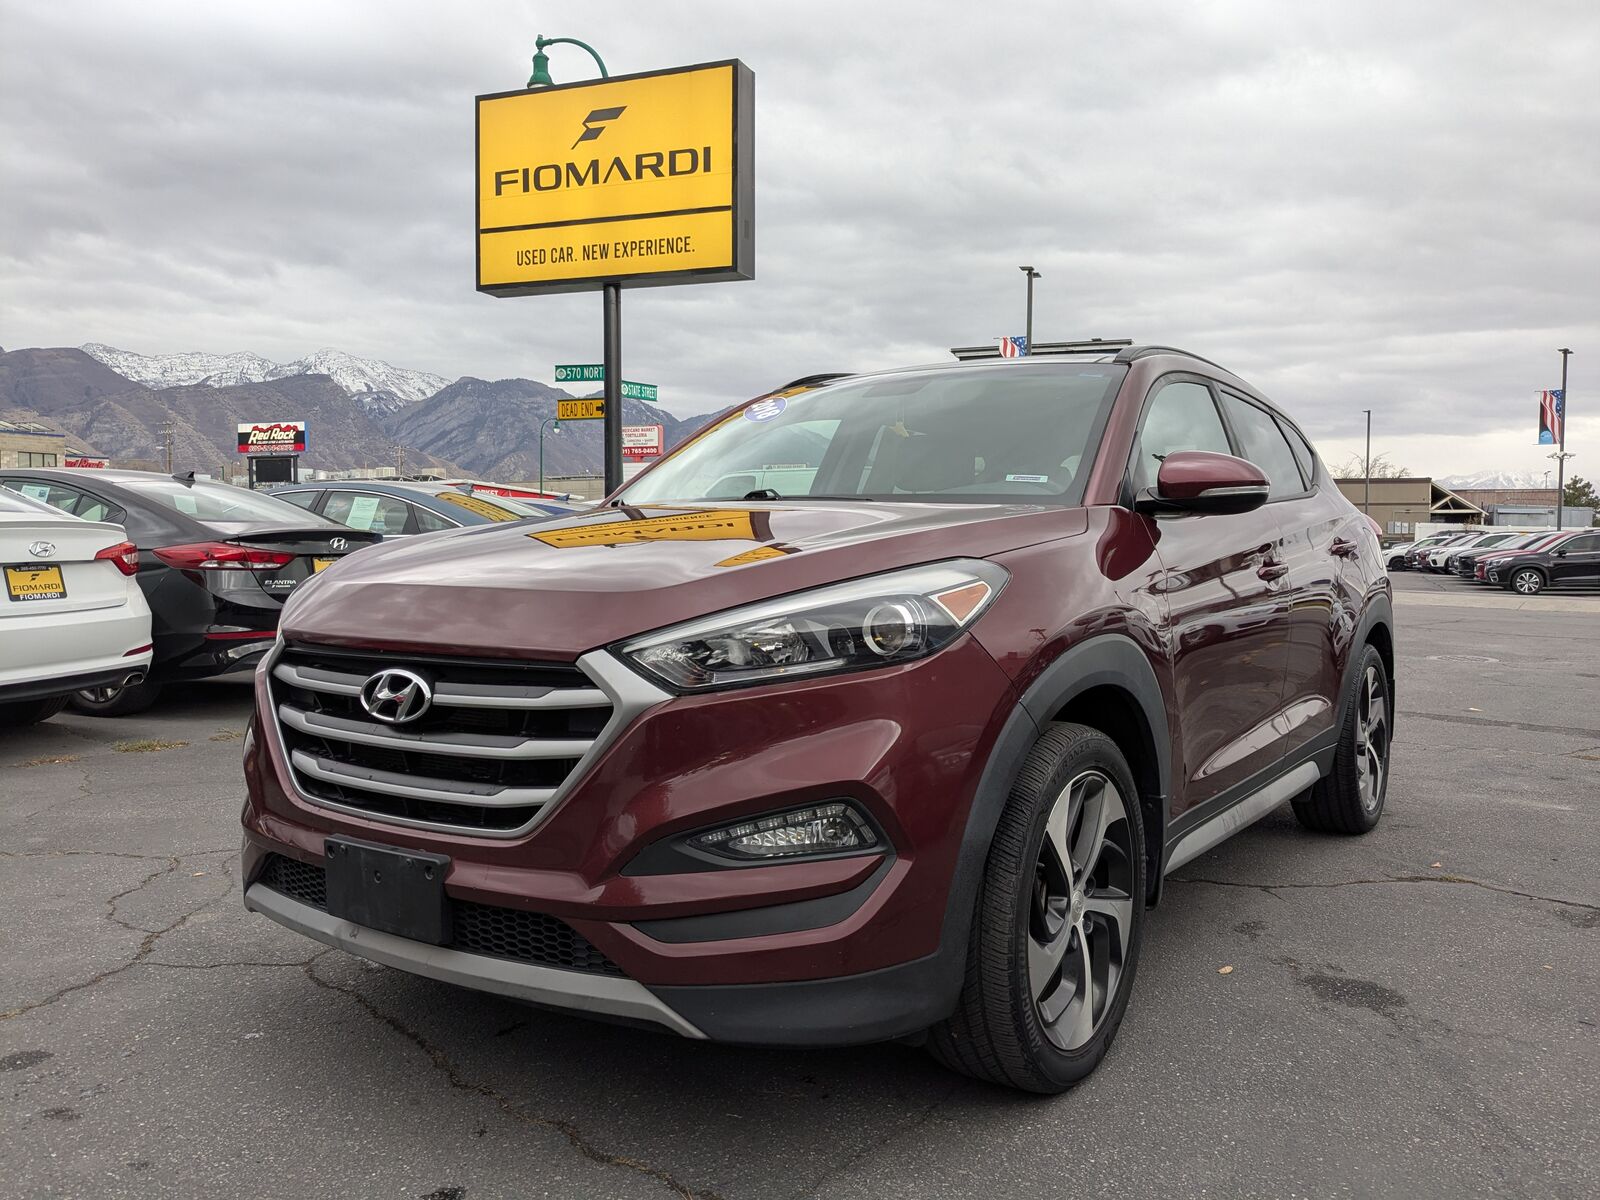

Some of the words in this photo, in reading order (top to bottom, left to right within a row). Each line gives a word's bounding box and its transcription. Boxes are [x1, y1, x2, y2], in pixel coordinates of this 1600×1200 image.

[494, 146, 711, 196] FIOMARDI
[516, 249, 547, 266] USED
[550, 246, 578, 263] CAR.
[582, 243, 610, 260] NEW
[613, 236, 695, 258] EXPERIENCE.
[566, 368, 580, 379] 570
[584, 367, 604, 378] NORT
[628, 385, 641, 396] STATE
[642, 387, 657, 399] STREET
[561, 403, 578, 417] DEAD
[581, 402, 594, 416] END
[248, 430, 271, 444] Red
[270, 428, 296, 440] Rock
[12, 583, 60, 592] FIOMARDI
[20, 592, 60, 600] FIOMARDI
